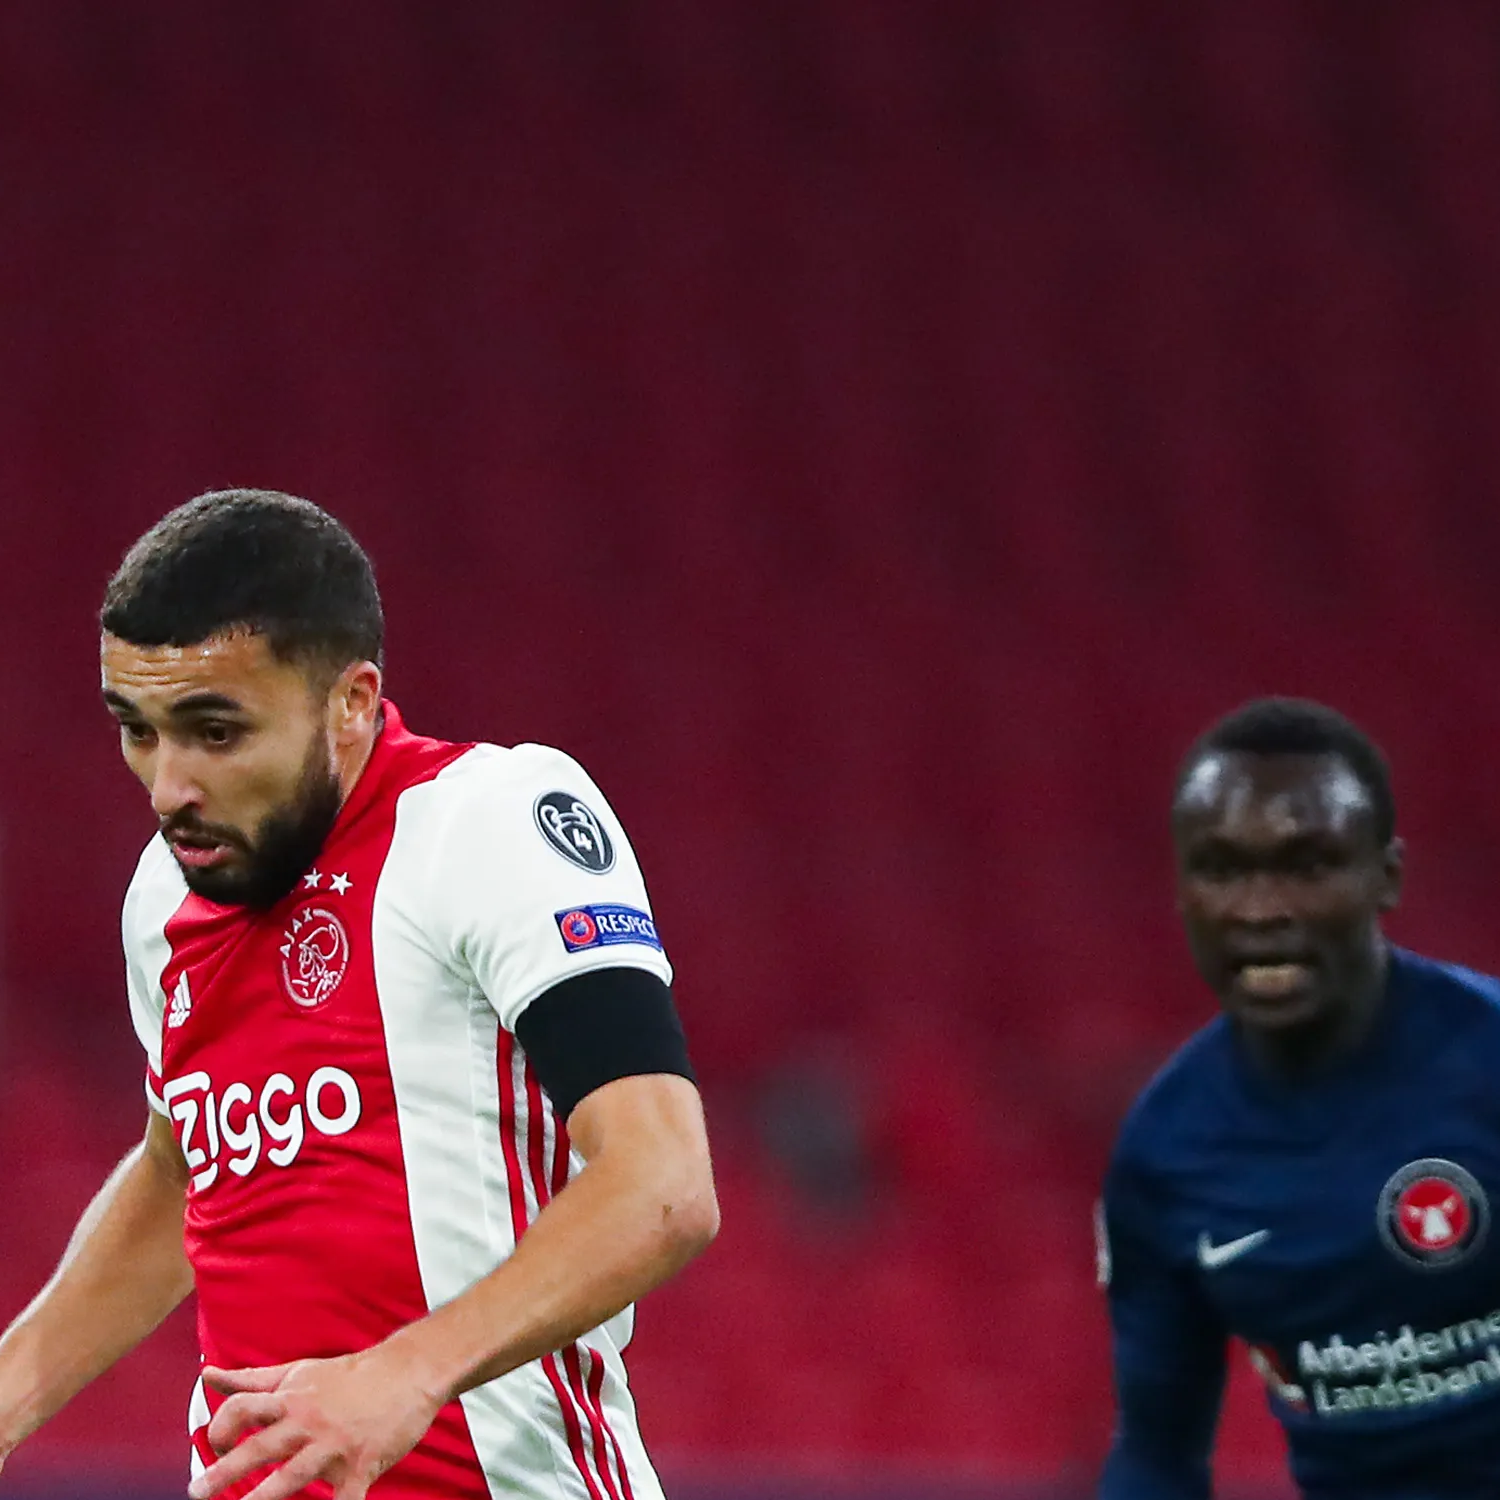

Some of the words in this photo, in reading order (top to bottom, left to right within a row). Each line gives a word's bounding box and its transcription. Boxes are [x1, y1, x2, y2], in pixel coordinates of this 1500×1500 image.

[572, 828, 593, 851] 4
[279, 907, 313, 959] AJAX
[595, 913, 657, 939] RESPECT
